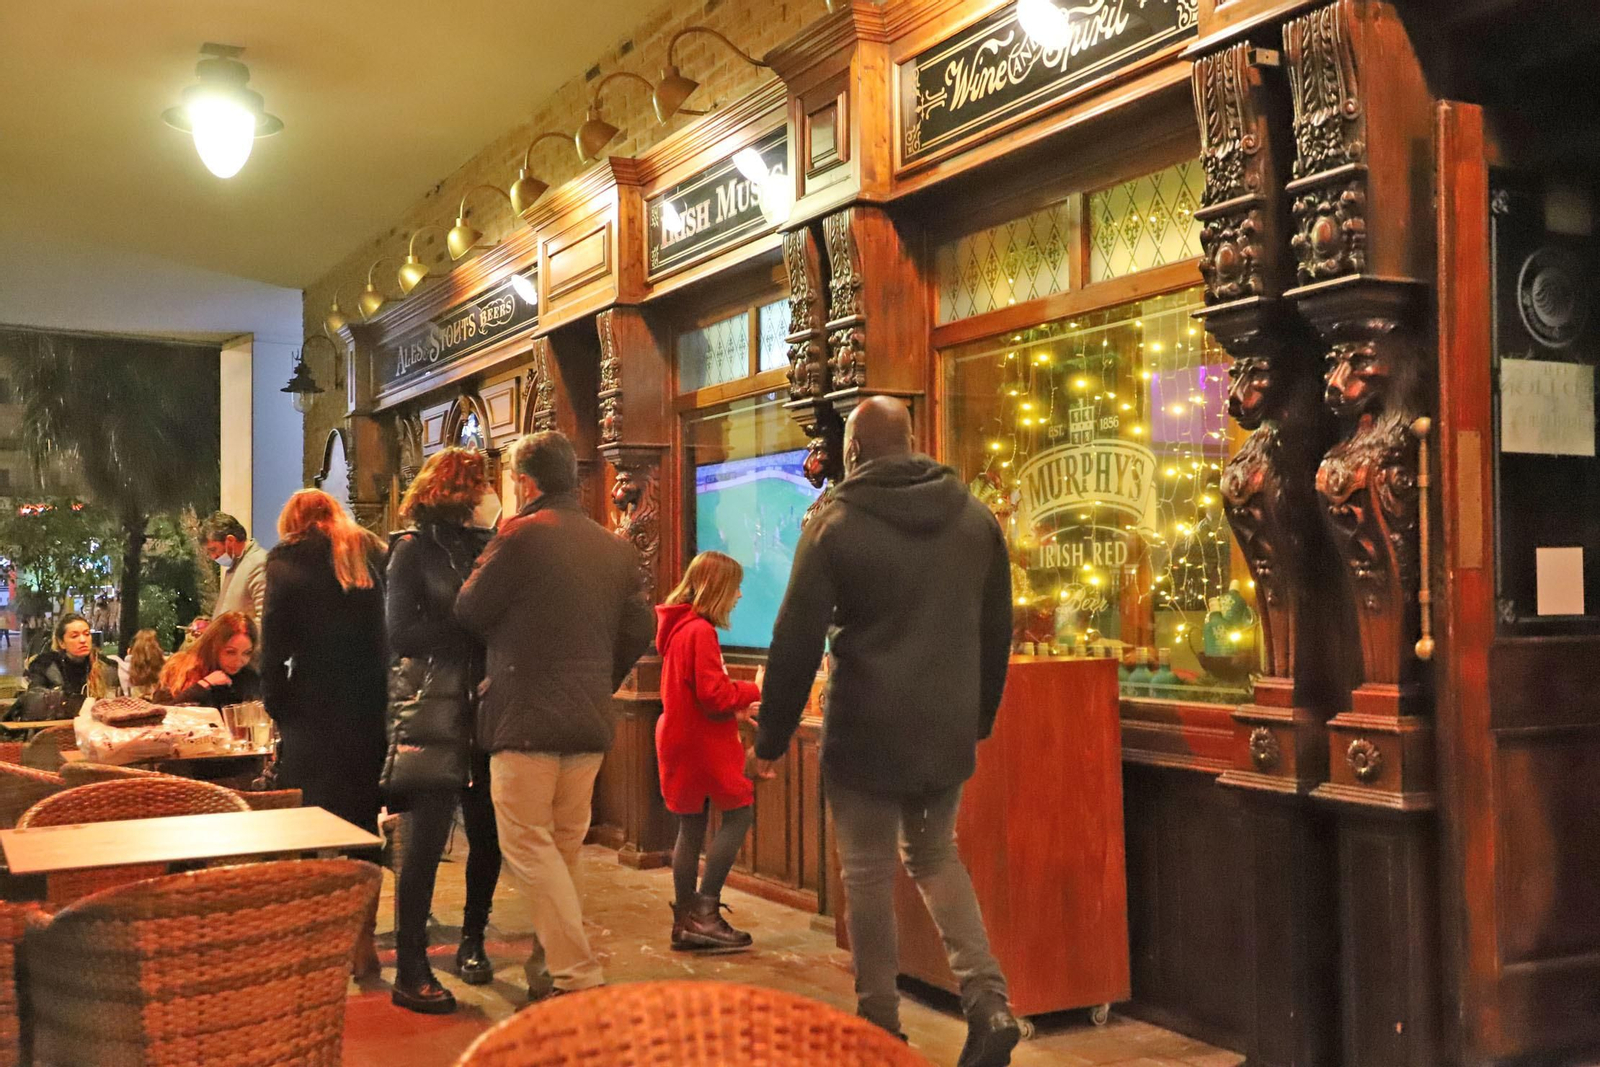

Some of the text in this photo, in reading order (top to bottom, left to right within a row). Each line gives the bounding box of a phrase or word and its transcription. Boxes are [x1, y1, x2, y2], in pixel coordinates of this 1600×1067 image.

[945, 31, 1014, 111] Wine
[715, 162, 784, 224] MUS
[395, 340, 423, 377] ALES
[429, 312, 476, 362] STOUTS
[479, 299, 512, 328] BEERS
[1100, 415, 1119, 430] 1856
[1025, 451, 1146, 511] MURPHY'S
[1040, 540, 1128, 568] IRISH RED
[1055, 582, 1109, 613] Beer
